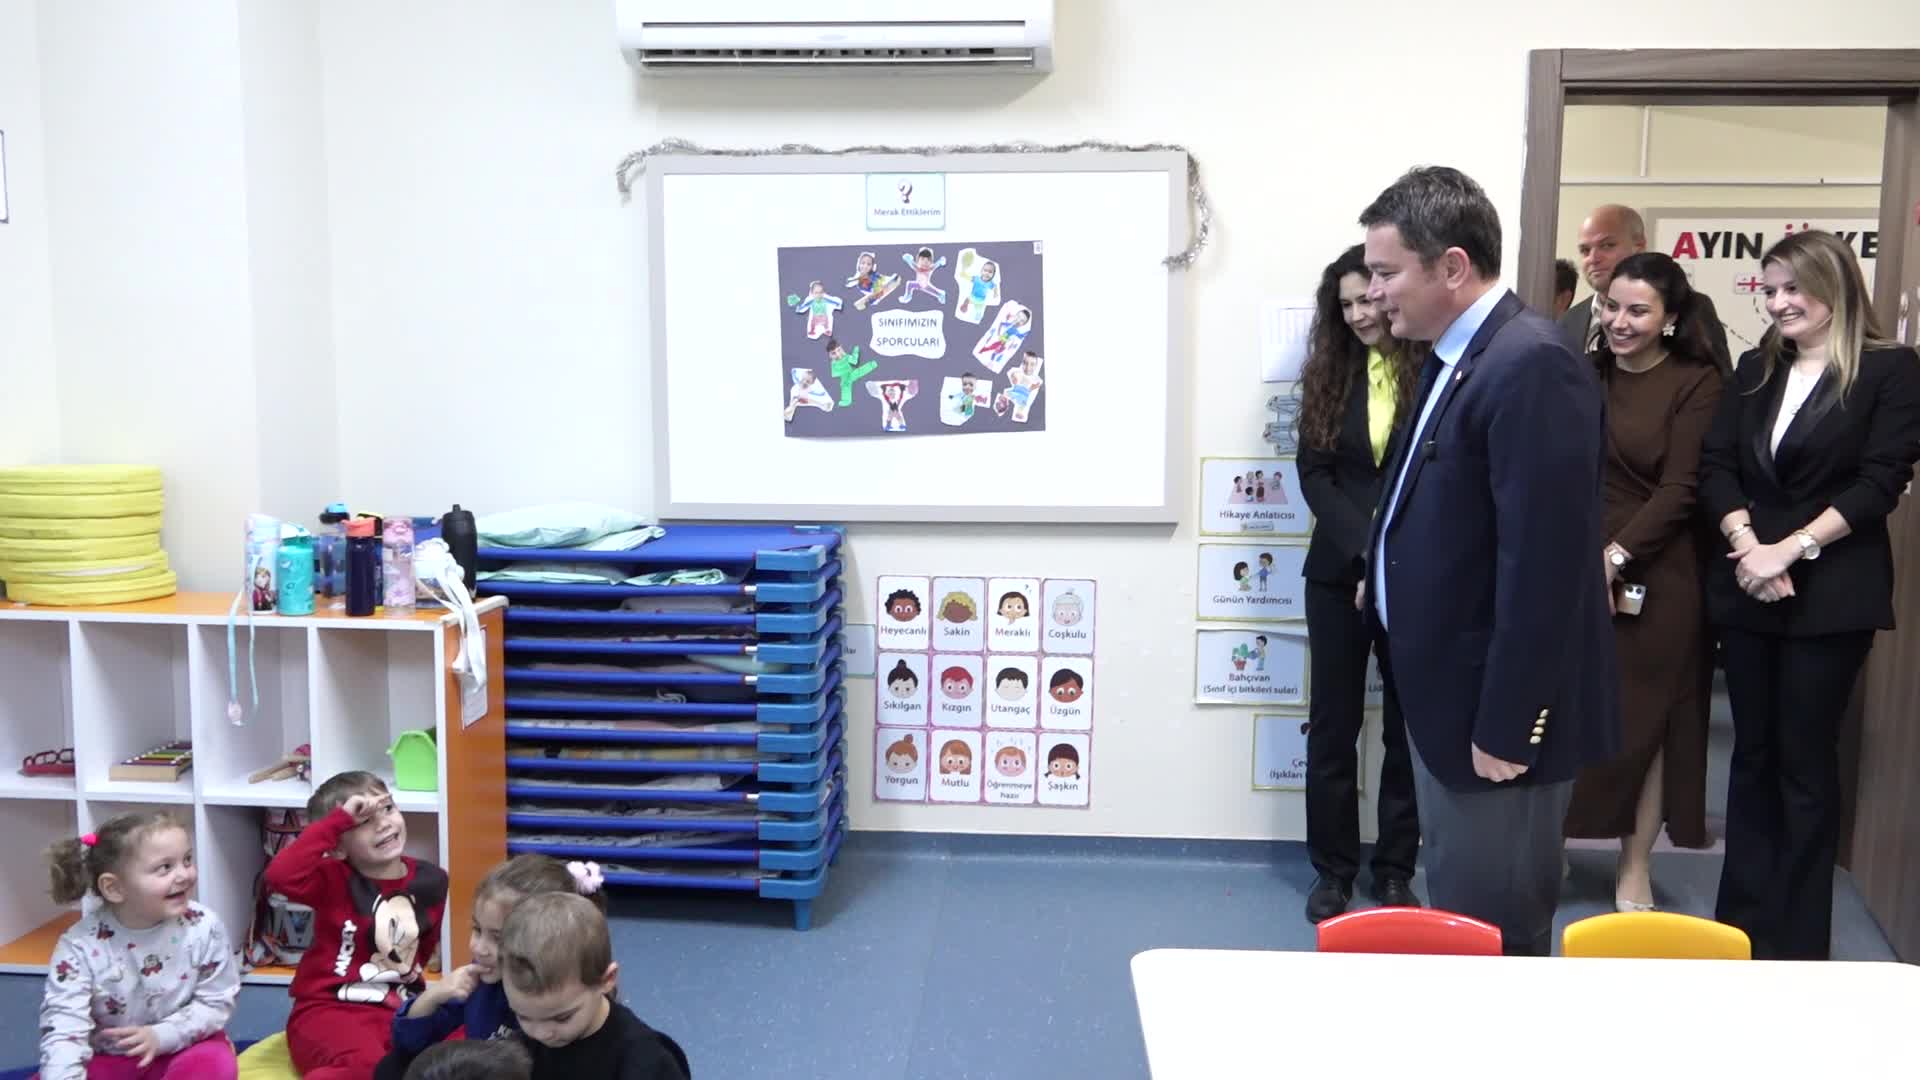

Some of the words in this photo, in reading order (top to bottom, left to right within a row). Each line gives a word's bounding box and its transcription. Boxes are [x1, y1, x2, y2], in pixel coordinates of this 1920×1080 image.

[874, 208, 899, 216] Merak
[901, 208, 941, 216] Ettiklerim
[1672, 231, 1764, 259] AYIN
[878, 318, 937, 327] SINIFIMIZIN
[876, 337, 940, 346] SPORCULARI
[1219, 510, 1250, 521] Hikaye
[1253, 510, 1295, 520] Anlatıcısı
[1213, 595, 1244, 604] Günün
[881, 626, 927, 638] Heyecanlı
[944, 627, 970, 637] Sakin
[995, 627, 1031, 637] Meraklı
[1048, 629, 1086, 640] Coşkulu
[1229, 673, 1270, 683] Bahçıvan
[884, 700, 921, 711] Sıkılgan
[942, 702, 972, 713] Kızgın
[991, 703, 1030, 714] Utangaç
[1050, 703, 1081, 716] Üzgün
[885, 775, 918, 786] Yorgun
[941, 778, 970, 788] Mutlu
[1048, 781, 1079, 791] Şaşkın
